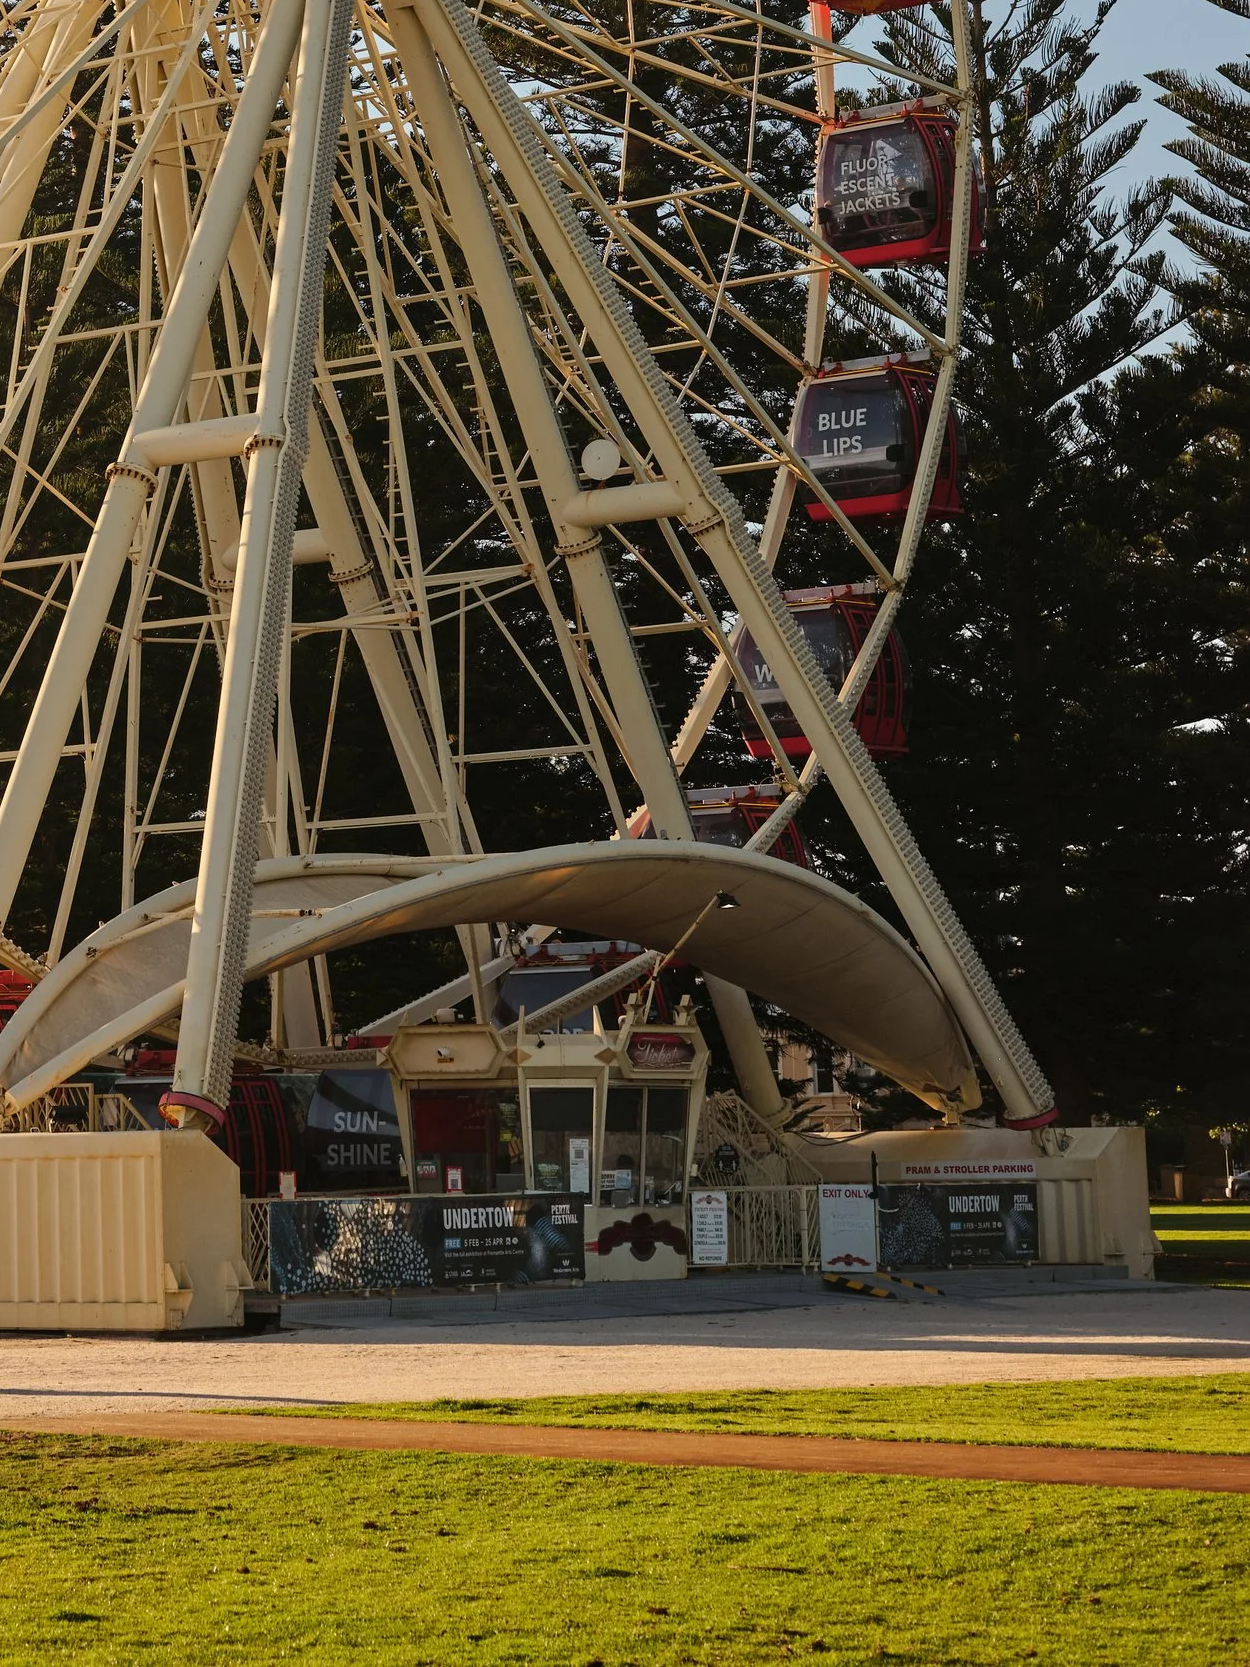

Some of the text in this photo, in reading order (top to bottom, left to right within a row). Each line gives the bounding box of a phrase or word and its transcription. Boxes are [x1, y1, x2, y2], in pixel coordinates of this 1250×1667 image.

[841, 155, 888, 175] FLUOR
[841, 173, 895, 194] ESCENT
[839, 192, 901, 214] JACKETS
[818, 407, 867, 431] BLUE
[823, 435, 863, 457] LIPS
[333, 1111, 387, 1133] SUN-
[327, 1143, 392, 1166] SHINE
[905, 1164, 1034, 1175] PRAM & STROLLER PARKING
[822, 1189, 870, 1199] EXIT ONLY
[1013, 1195, 1028, 1203] PERTH
[551, 1204, 570, 1215] PERTH
[949, 1195, 1000, 1213] UNDERTOW
[1013, 1202, 1034, 1212] FESTIVAL
[443, 1206, 514, 1230] UNDERTOW
[551, 1214, 578, 1225] FESTIVAL
[445, 1238, 461, 1247] FREE
[485, 1238, 491, 1246] 25
[492, 1238, 503, 1246] APR
